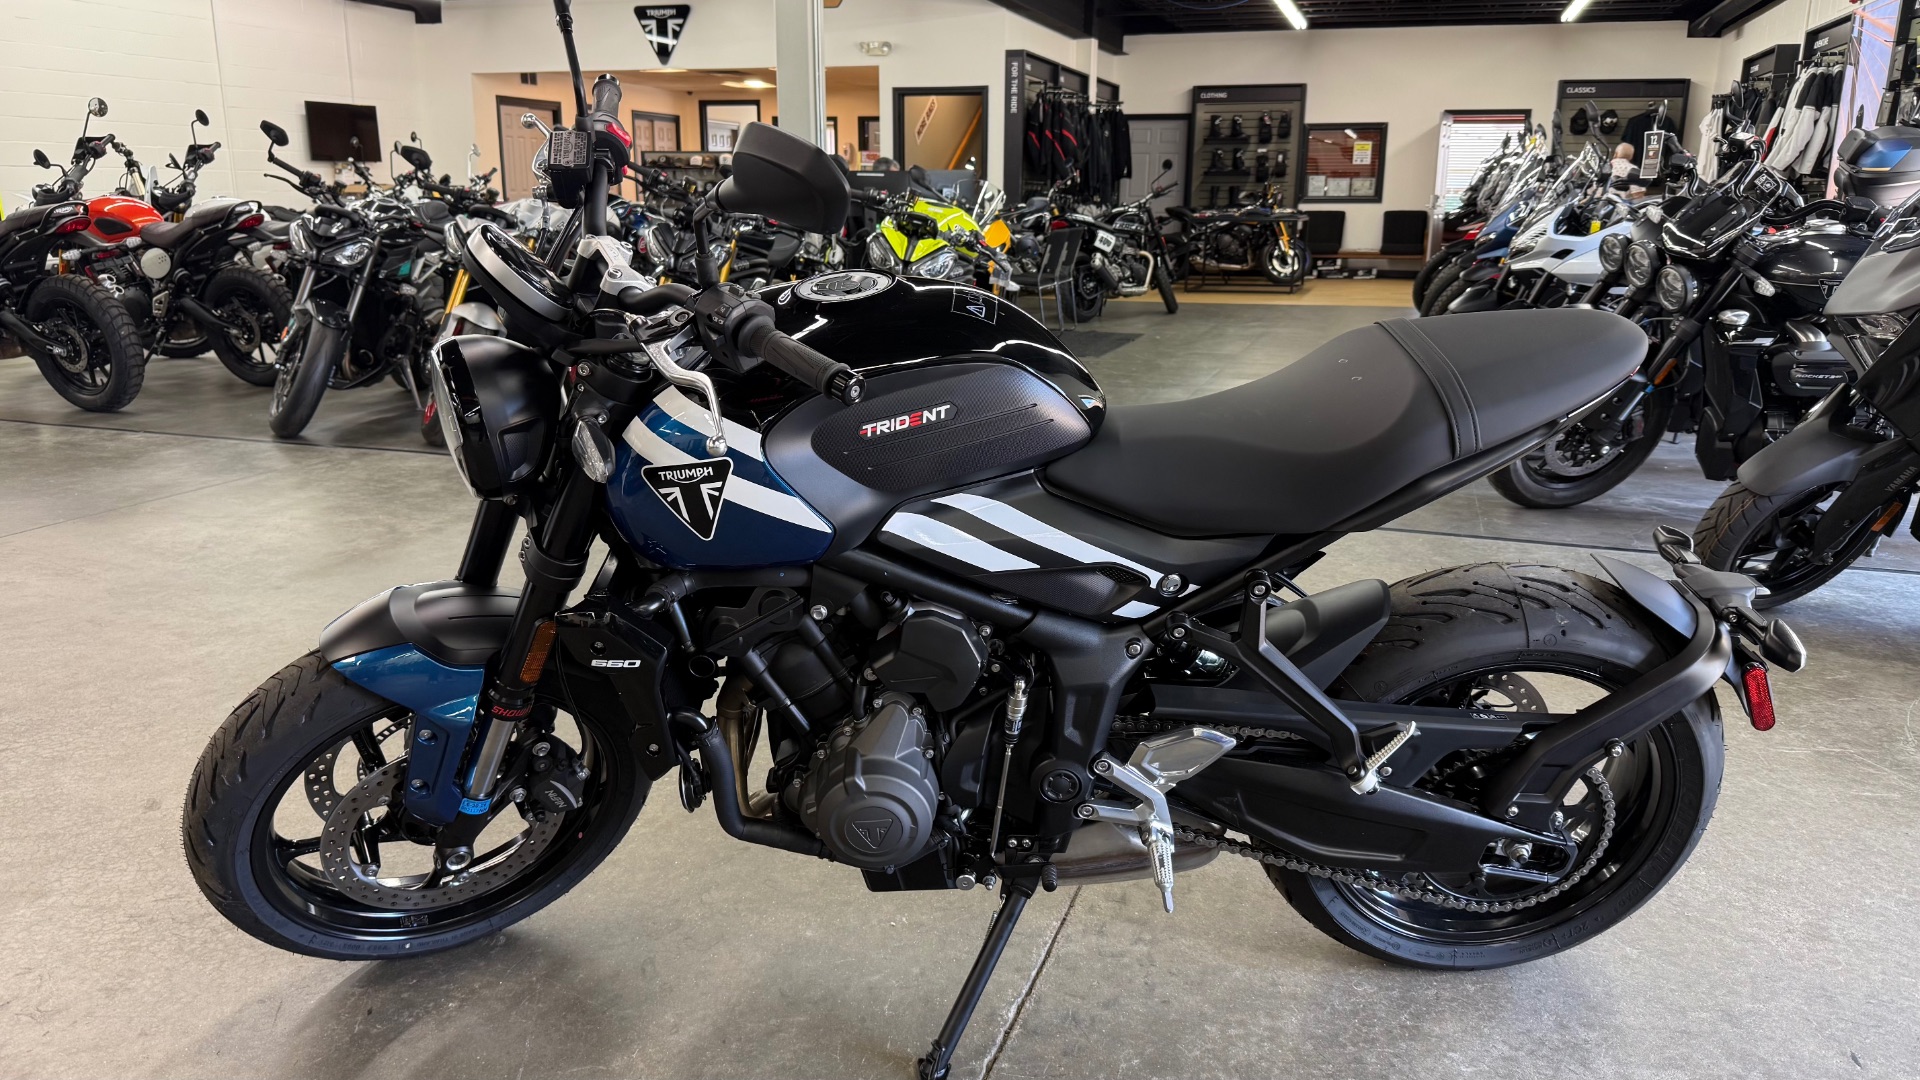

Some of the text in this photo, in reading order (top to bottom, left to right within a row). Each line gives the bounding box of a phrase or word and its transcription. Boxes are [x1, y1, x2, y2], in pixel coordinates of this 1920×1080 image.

[646, 8, 676, 16] TRIUMPH
[1010, 62, 1018, 114] FOR THE RIDE
[1650, 135, 1658, 145] 12
[860, 405, 951, 437] TRIDENT
[658, 467, 714, 481] TRIUMPH
[591, 659, 641, 667] 660
